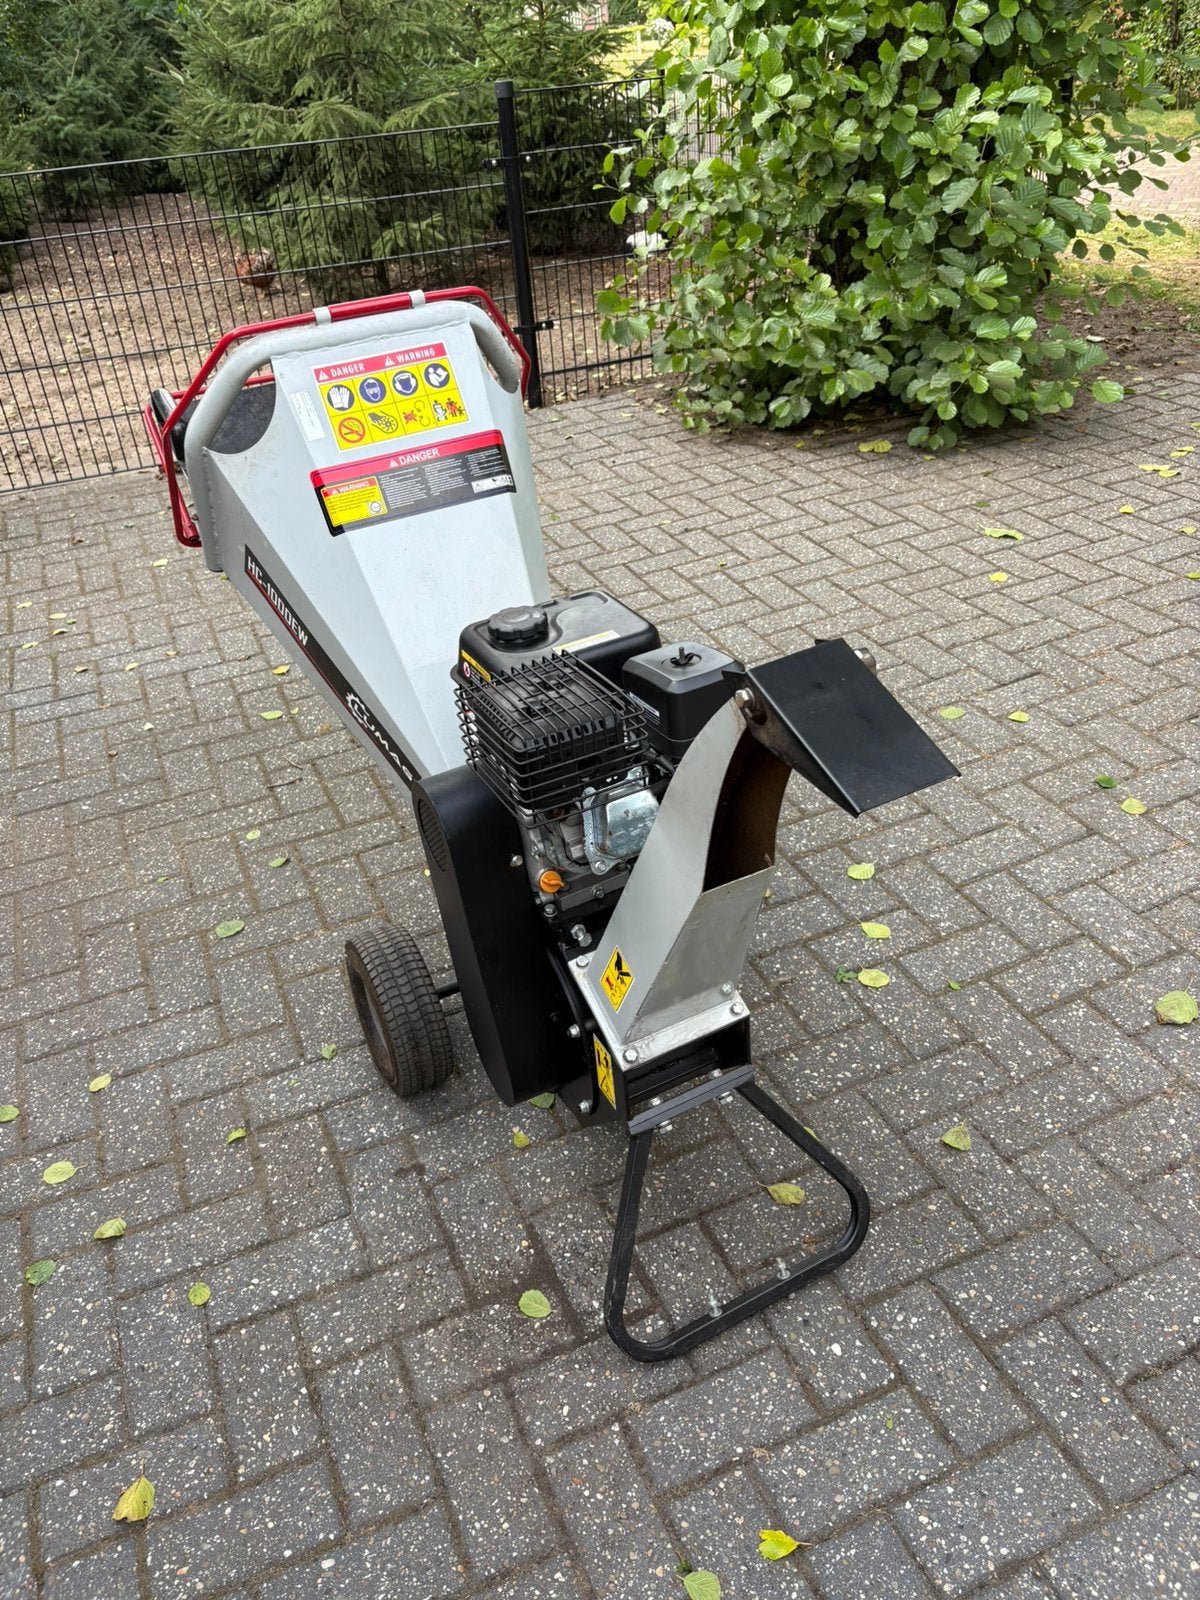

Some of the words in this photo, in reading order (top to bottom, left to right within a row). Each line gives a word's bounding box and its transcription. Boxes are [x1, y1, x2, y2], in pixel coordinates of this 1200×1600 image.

[330, 363, 365, 378] DANGER
[396, 348, 435, 363] WARNING
[398, 448, 440, 465] DANGER
[248, 556, 308, 646] HC-1000EW
